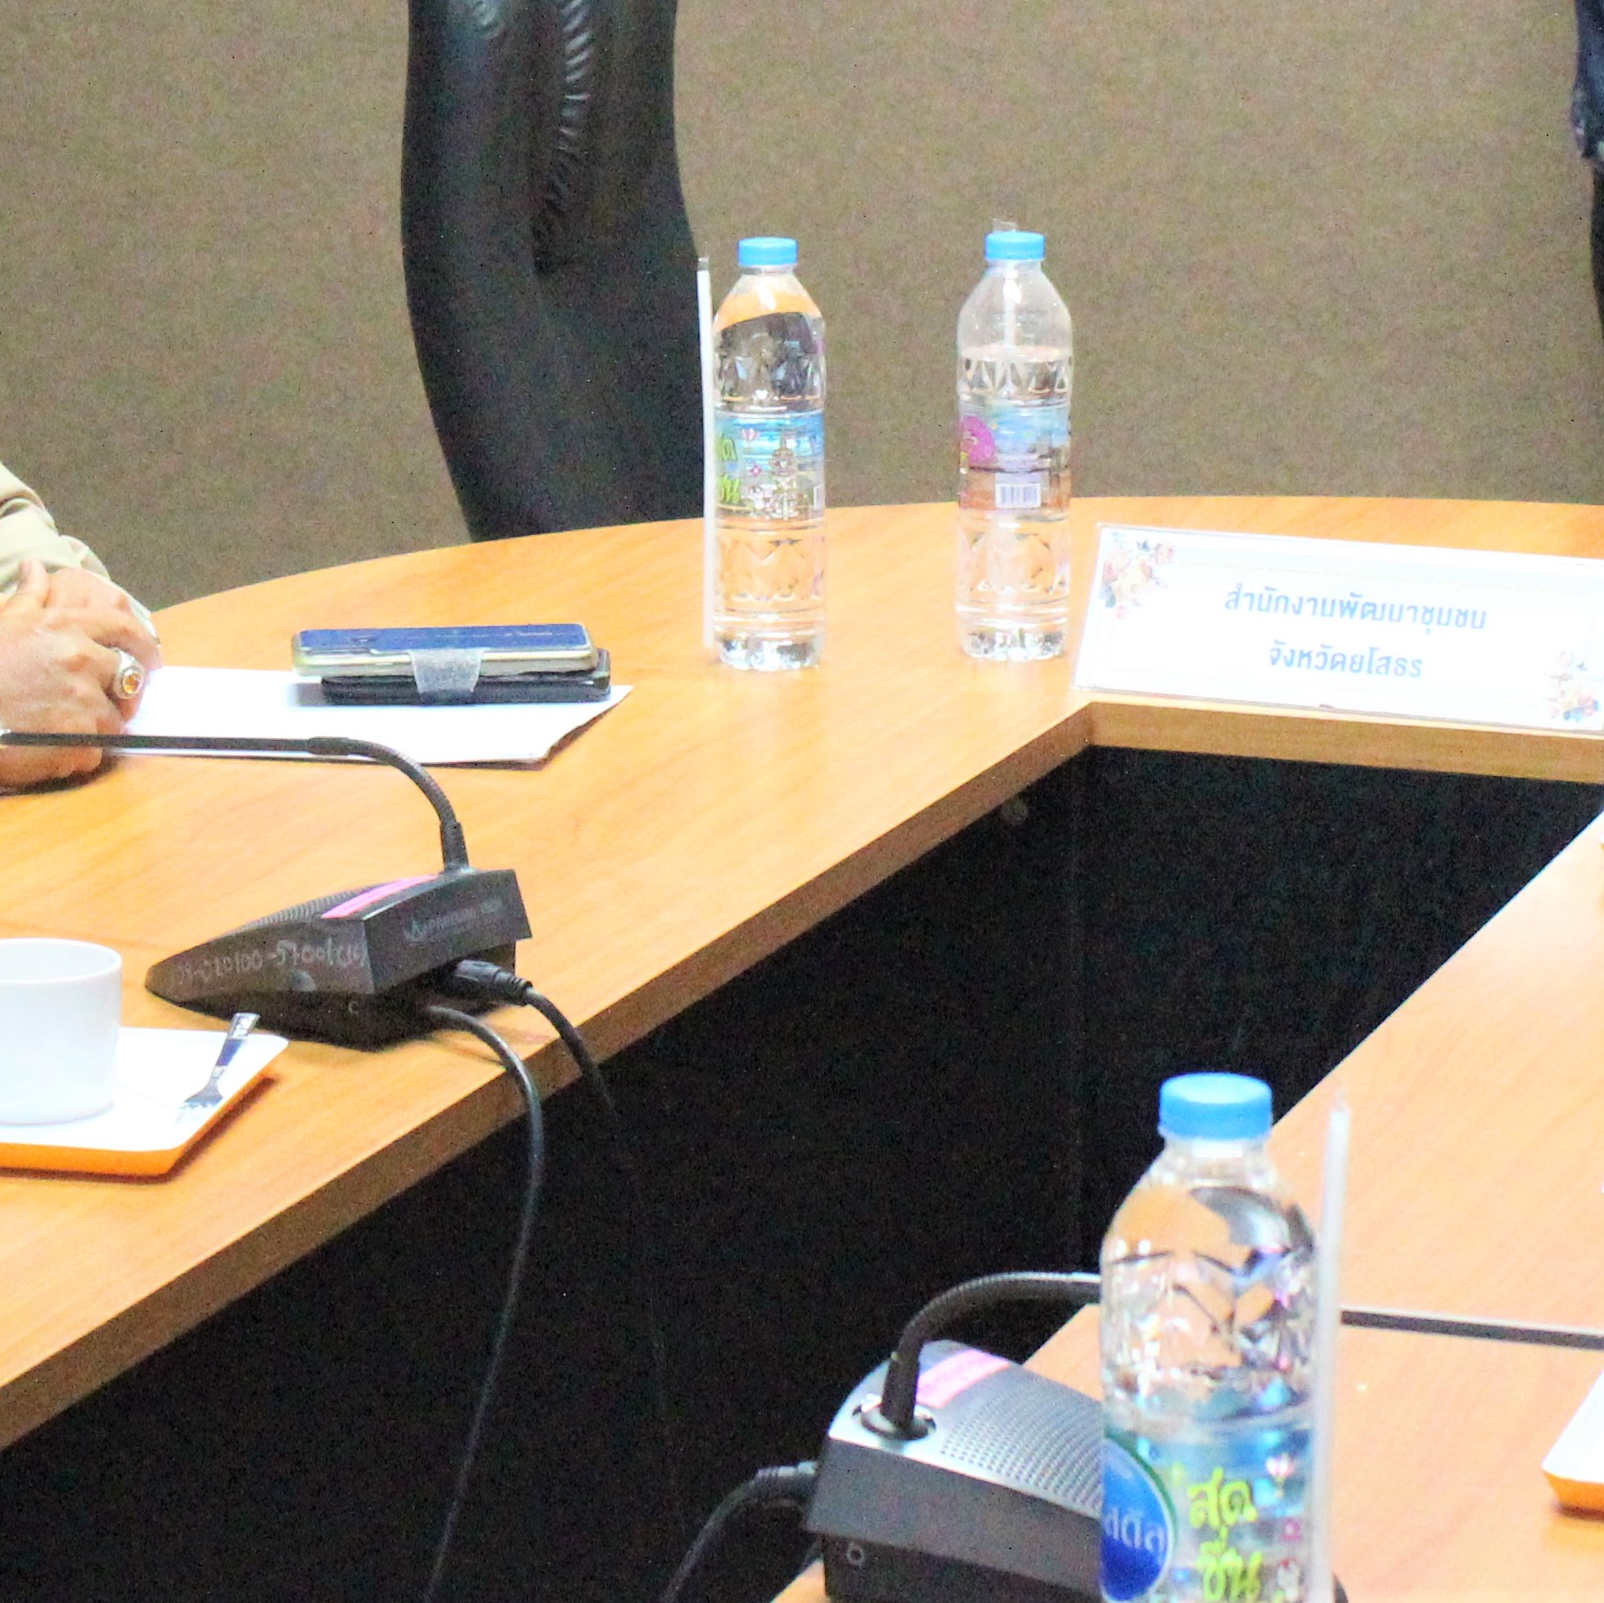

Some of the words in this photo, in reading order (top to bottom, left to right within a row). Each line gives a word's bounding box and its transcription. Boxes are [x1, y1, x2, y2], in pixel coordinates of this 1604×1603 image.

[1223, 582, 1487, 635] สำนักงานพัฒนาชุมชน
[1268, 640, 1423, 679] จังหวัดยโสธร
[1186, 1466, 1259, 1529] สด
